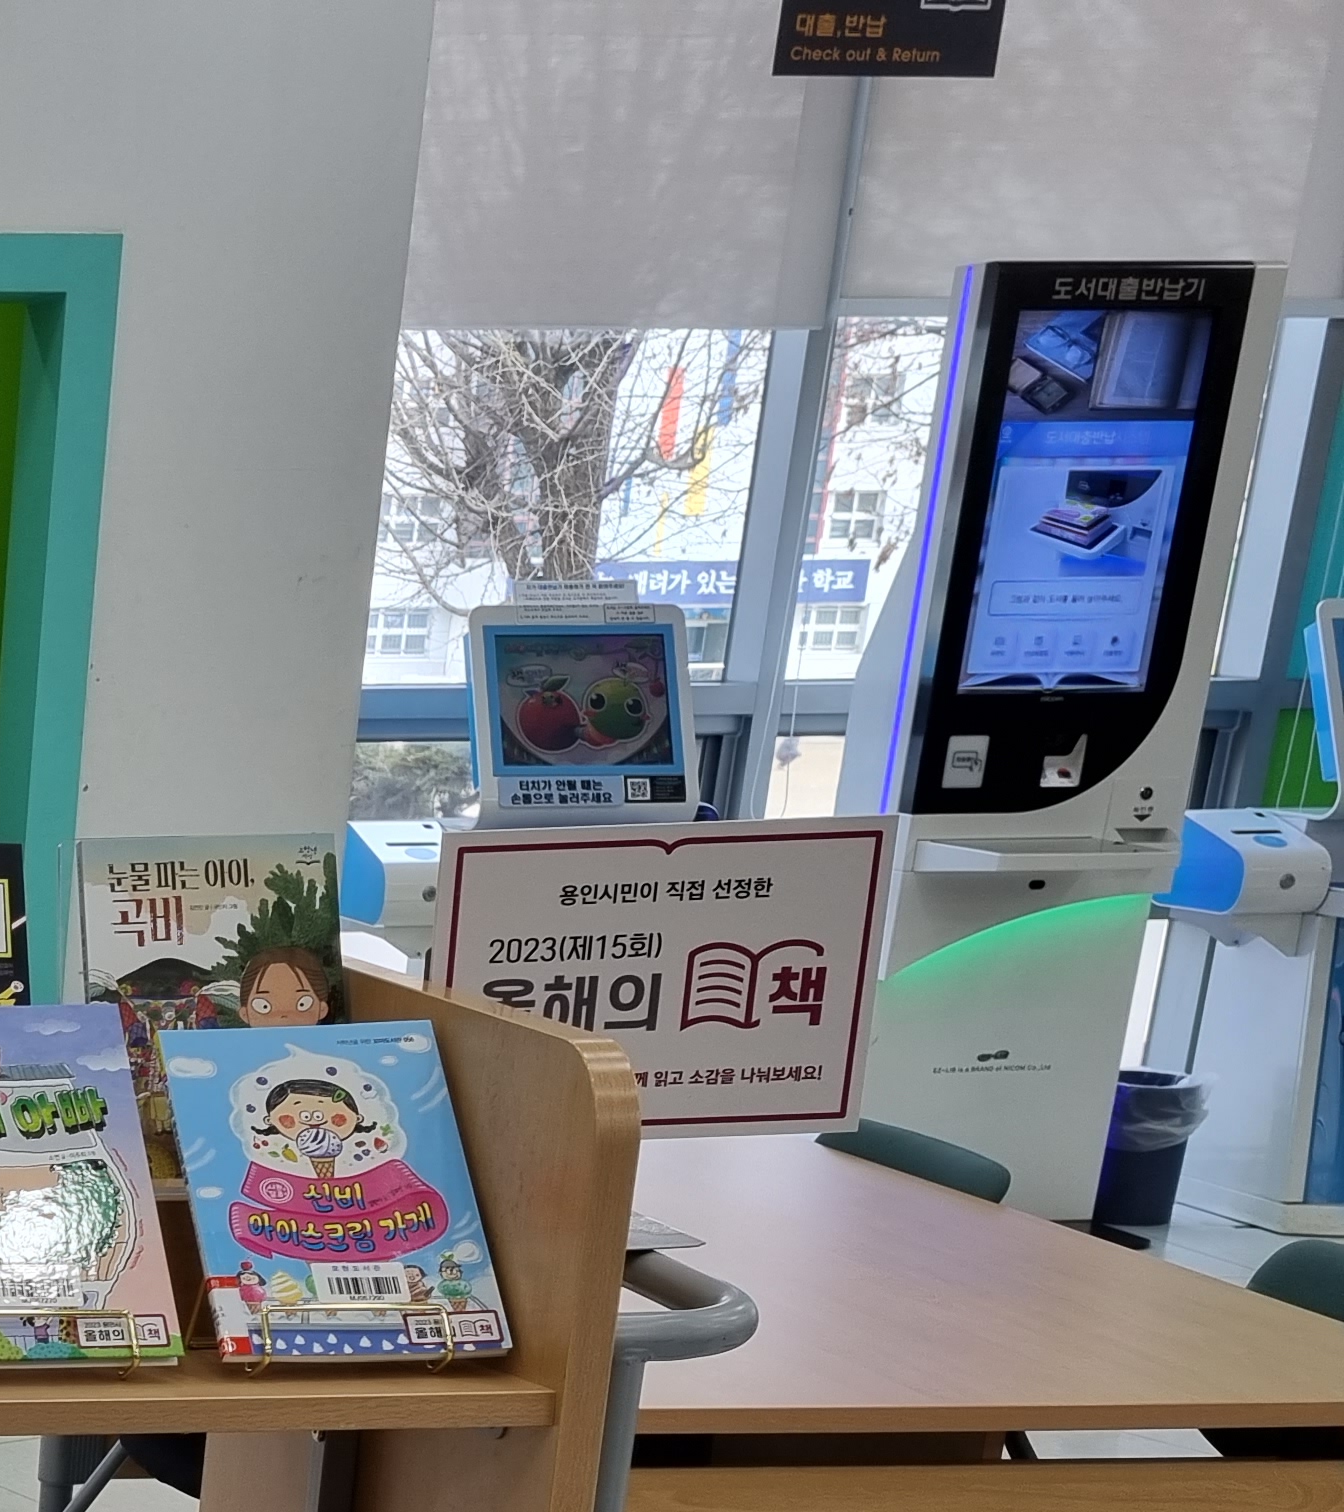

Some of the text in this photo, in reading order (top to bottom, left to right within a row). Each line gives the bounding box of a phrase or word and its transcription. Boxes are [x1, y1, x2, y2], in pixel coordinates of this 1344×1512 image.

[790, 46, 940, 62] Check out & Return
[1052, 277, 1206, 300] 도서대출반납기
[812, 570, 855, 597] 학교
[518, 779, 552, 792] 터치가
[107, 857, 255, 893] 눈물 파는 아이,
[558, 876, 773, 907] 용인시민이 직접 선정한
[110, 895, 184, 948] 곡비
[488, 932, 663, 964] 2023(제15회)
[769, 965, 827, 1026] 책
[654, 1069, 684, 1087] 읽고
[688, 1067, 736, 1086] 소감을
[740, 1064, 822, 1084] 나눠보세요!
[12, 1086, 109, 1139] 아빠
[302, 1182, 367, 1213] 신비
[247, 1202, 435, 1253] 아이스크림 가게
[84, 1328, 161, 1342] 올해의 책
[479, 1324, 494, 1337] 책
